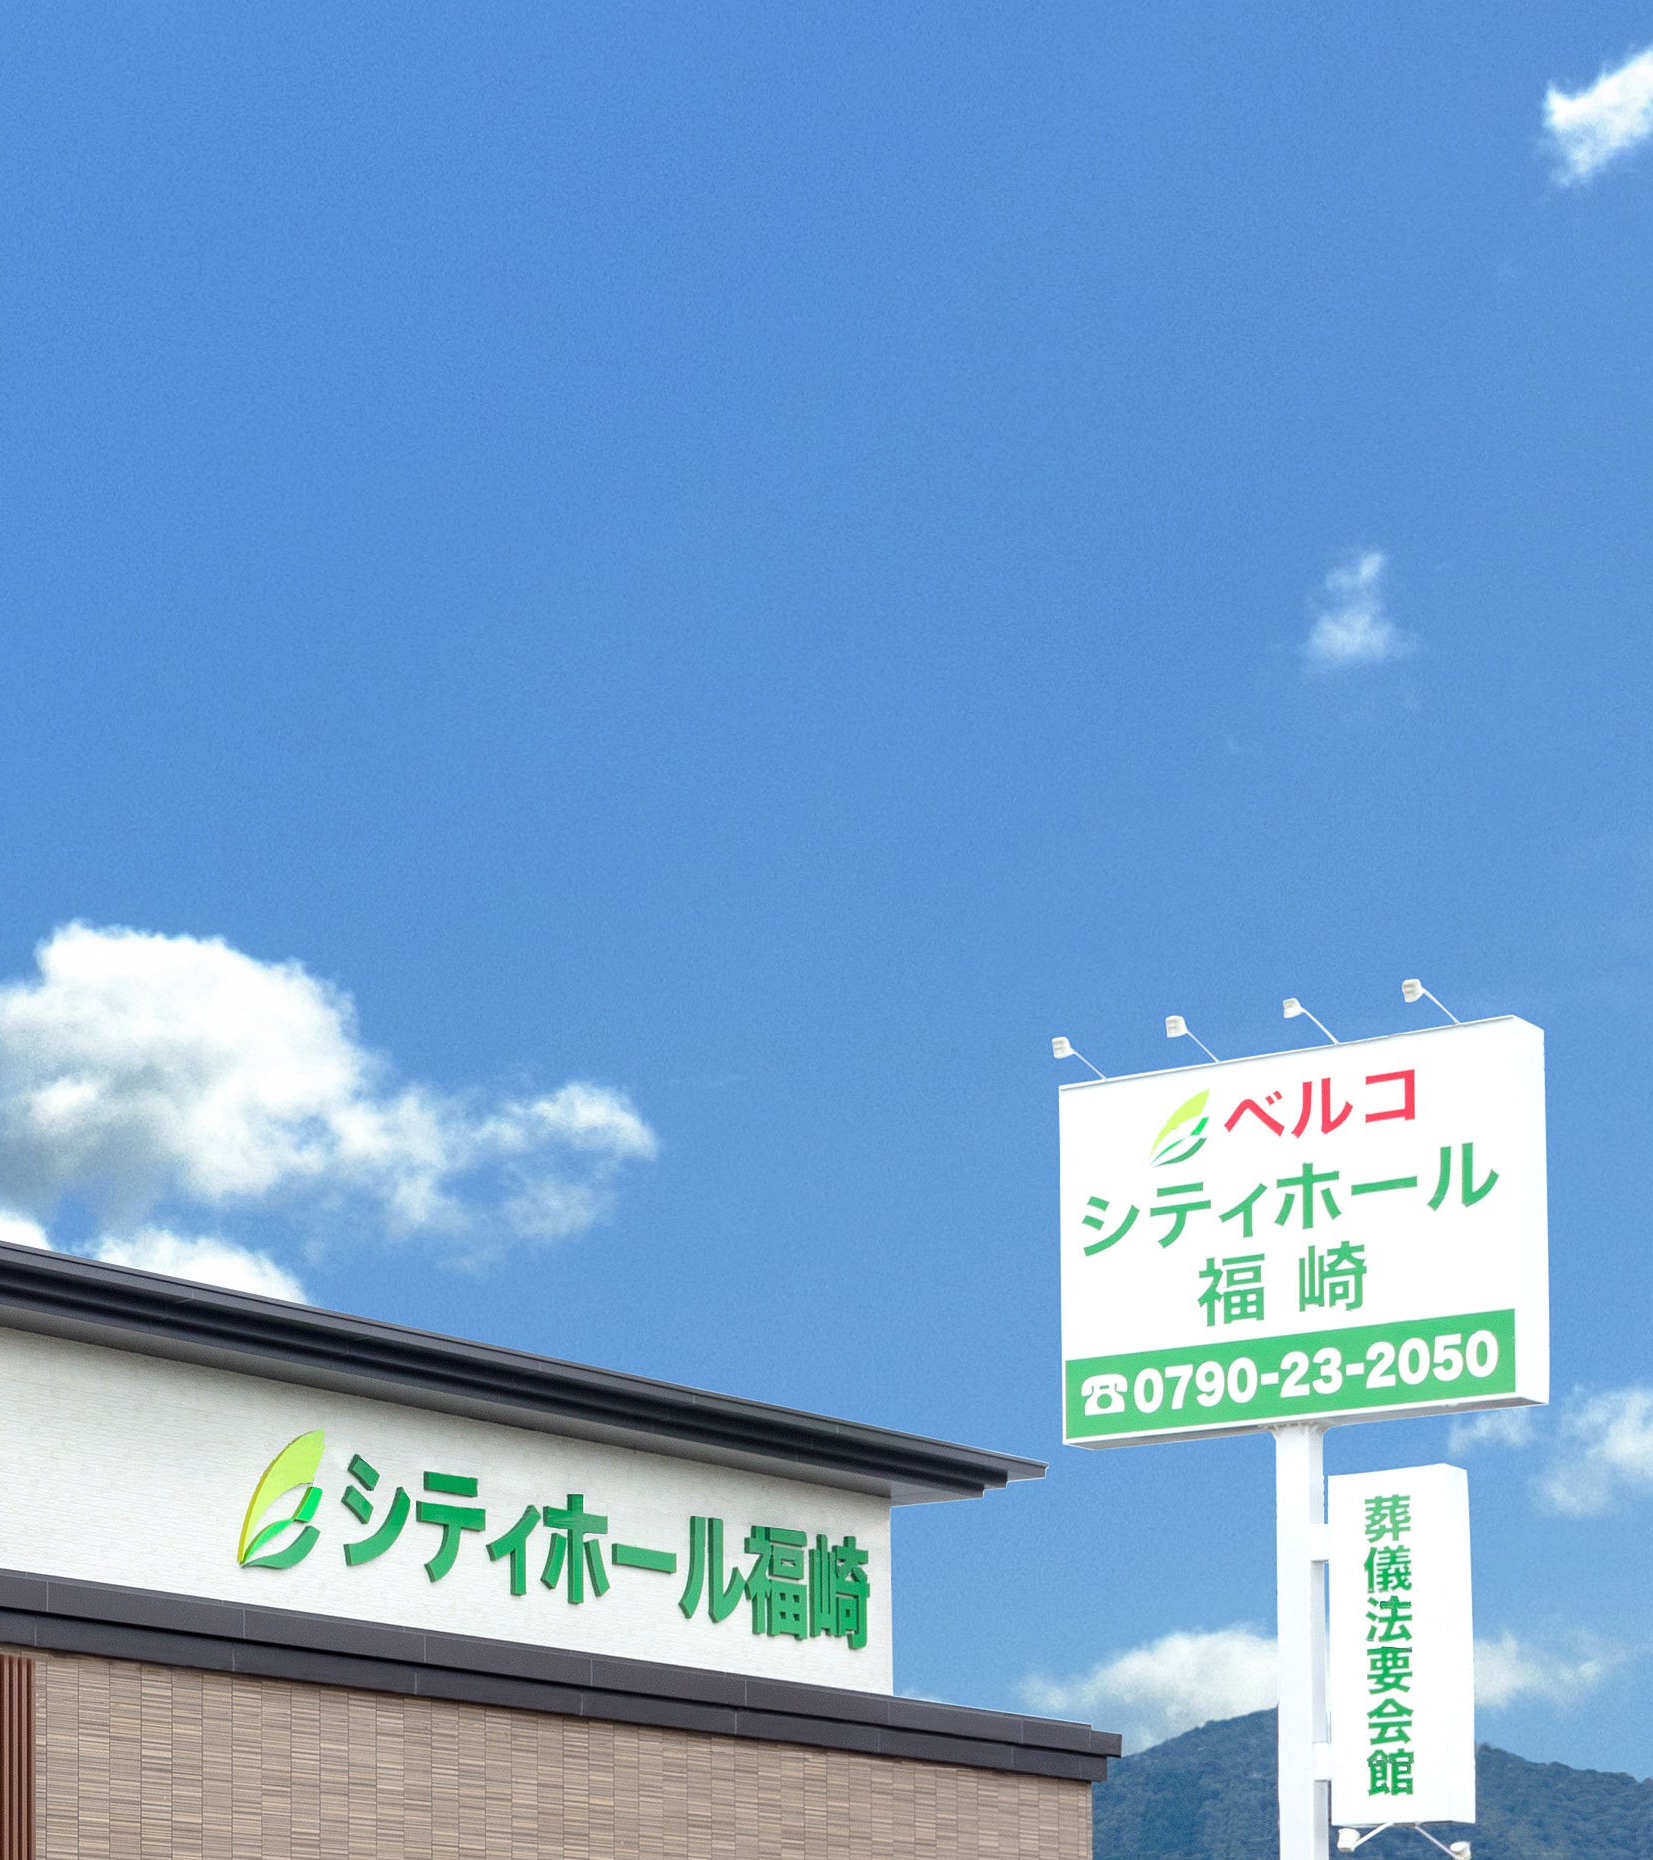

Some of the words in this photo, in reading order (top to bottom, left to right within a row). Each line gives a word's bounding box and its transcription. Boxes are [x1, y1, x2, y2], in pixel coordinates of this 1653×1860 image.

[1224, 1068, 1416, 1138] ベルコ
[1082, 1143, 1499, 1256] シティホール
[1198, 1241, 1368, 1328] 福崎
[1135, 1329, 1499, 1414] 0790-23-2050
[341, 1453, 871, 1650] シティホール福崎
[1364, 1494, 1414, 1796] 葬儀法要会館
